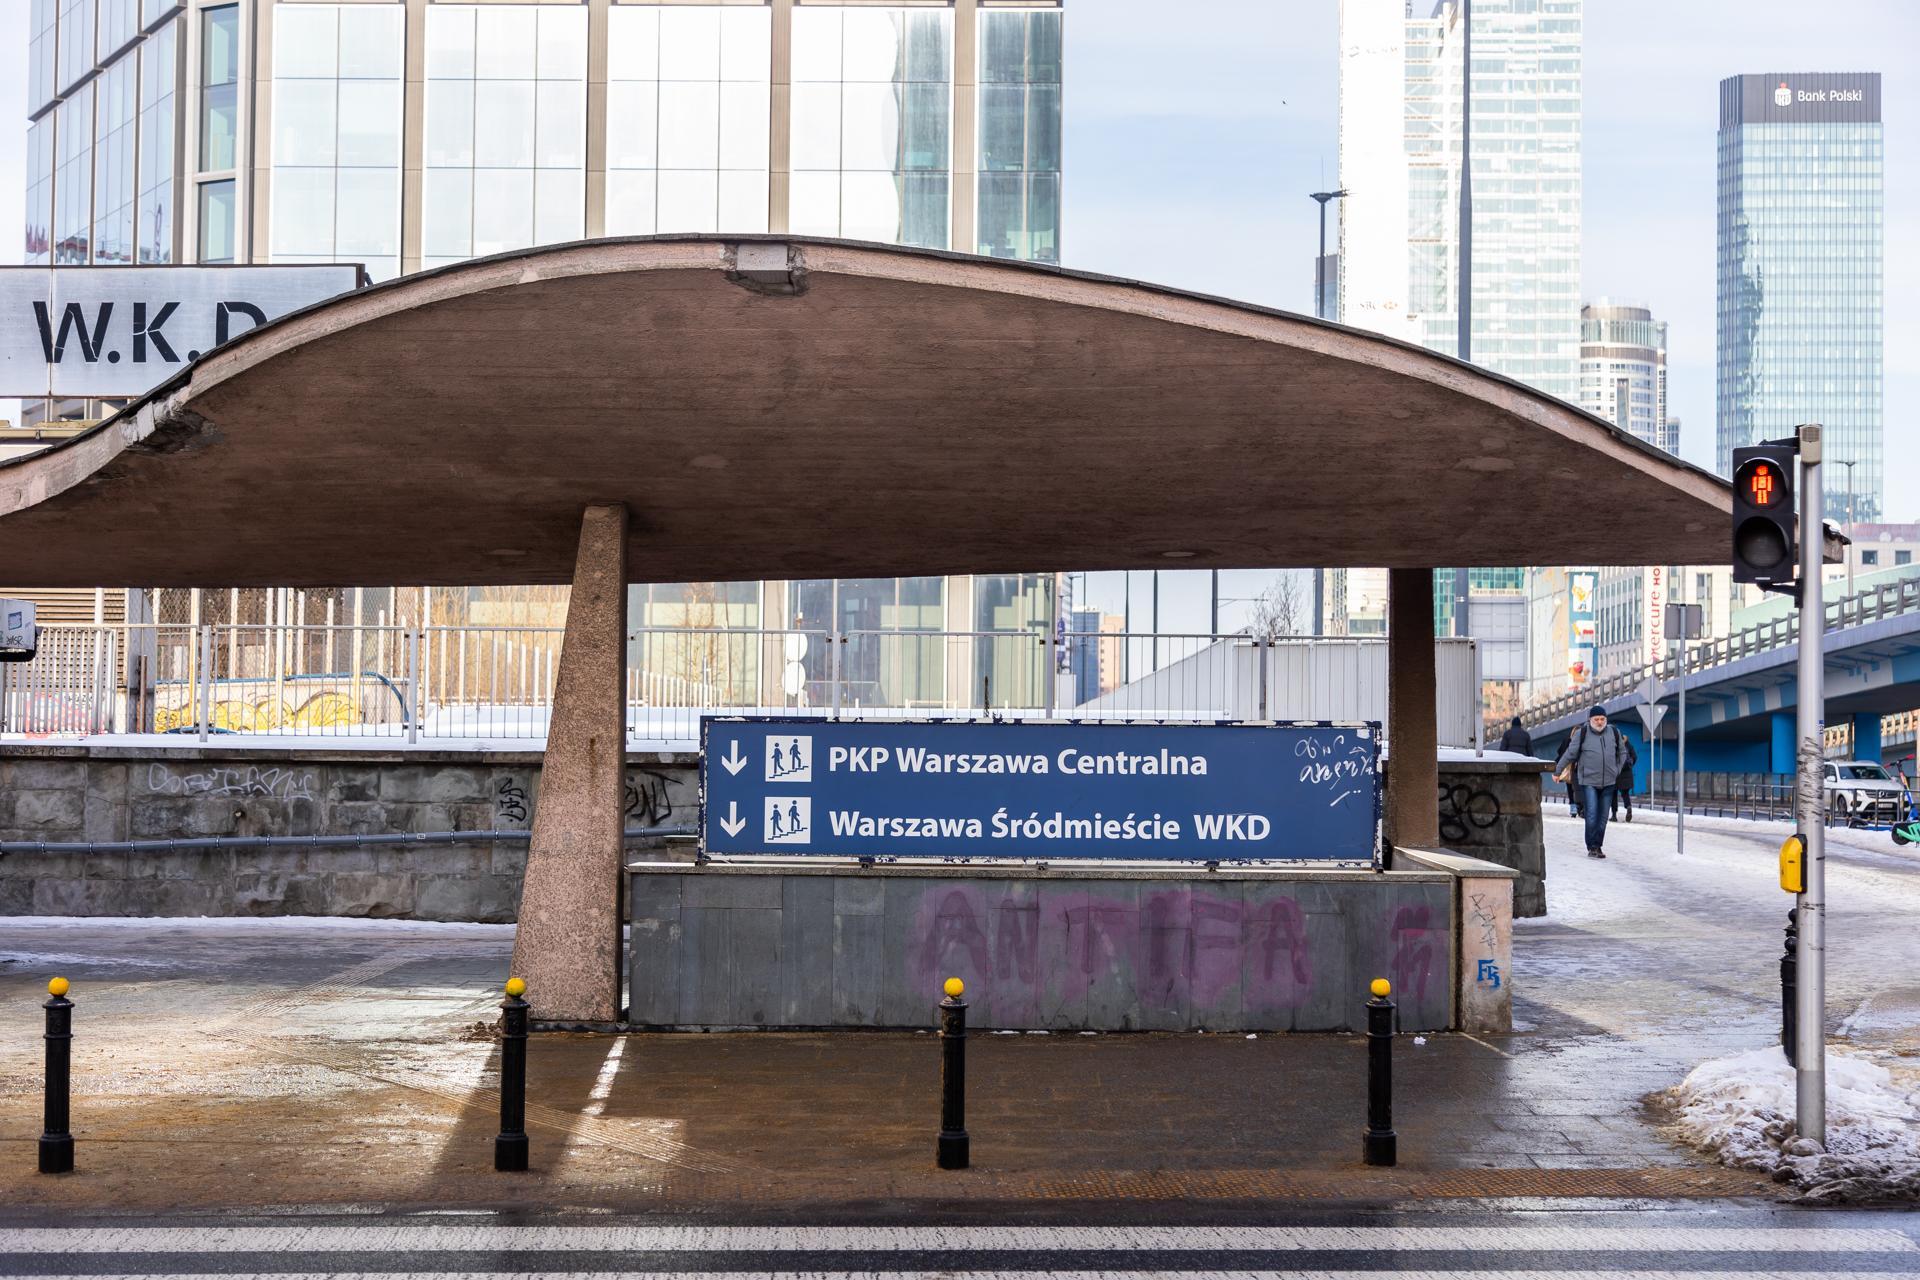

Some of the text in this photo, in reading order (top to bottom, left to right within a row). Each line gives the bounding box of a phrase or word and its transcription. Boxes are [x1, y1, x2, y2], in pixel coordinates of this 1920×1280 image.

[1797, 89, 1826, 102] Bank
[1829, 89, 1862, 102] Polski
[829, 746, 1208, 775] PKP Warszawa Centralna
[829, 807, 1271, 841] Warszawa Śródmieście WKD
